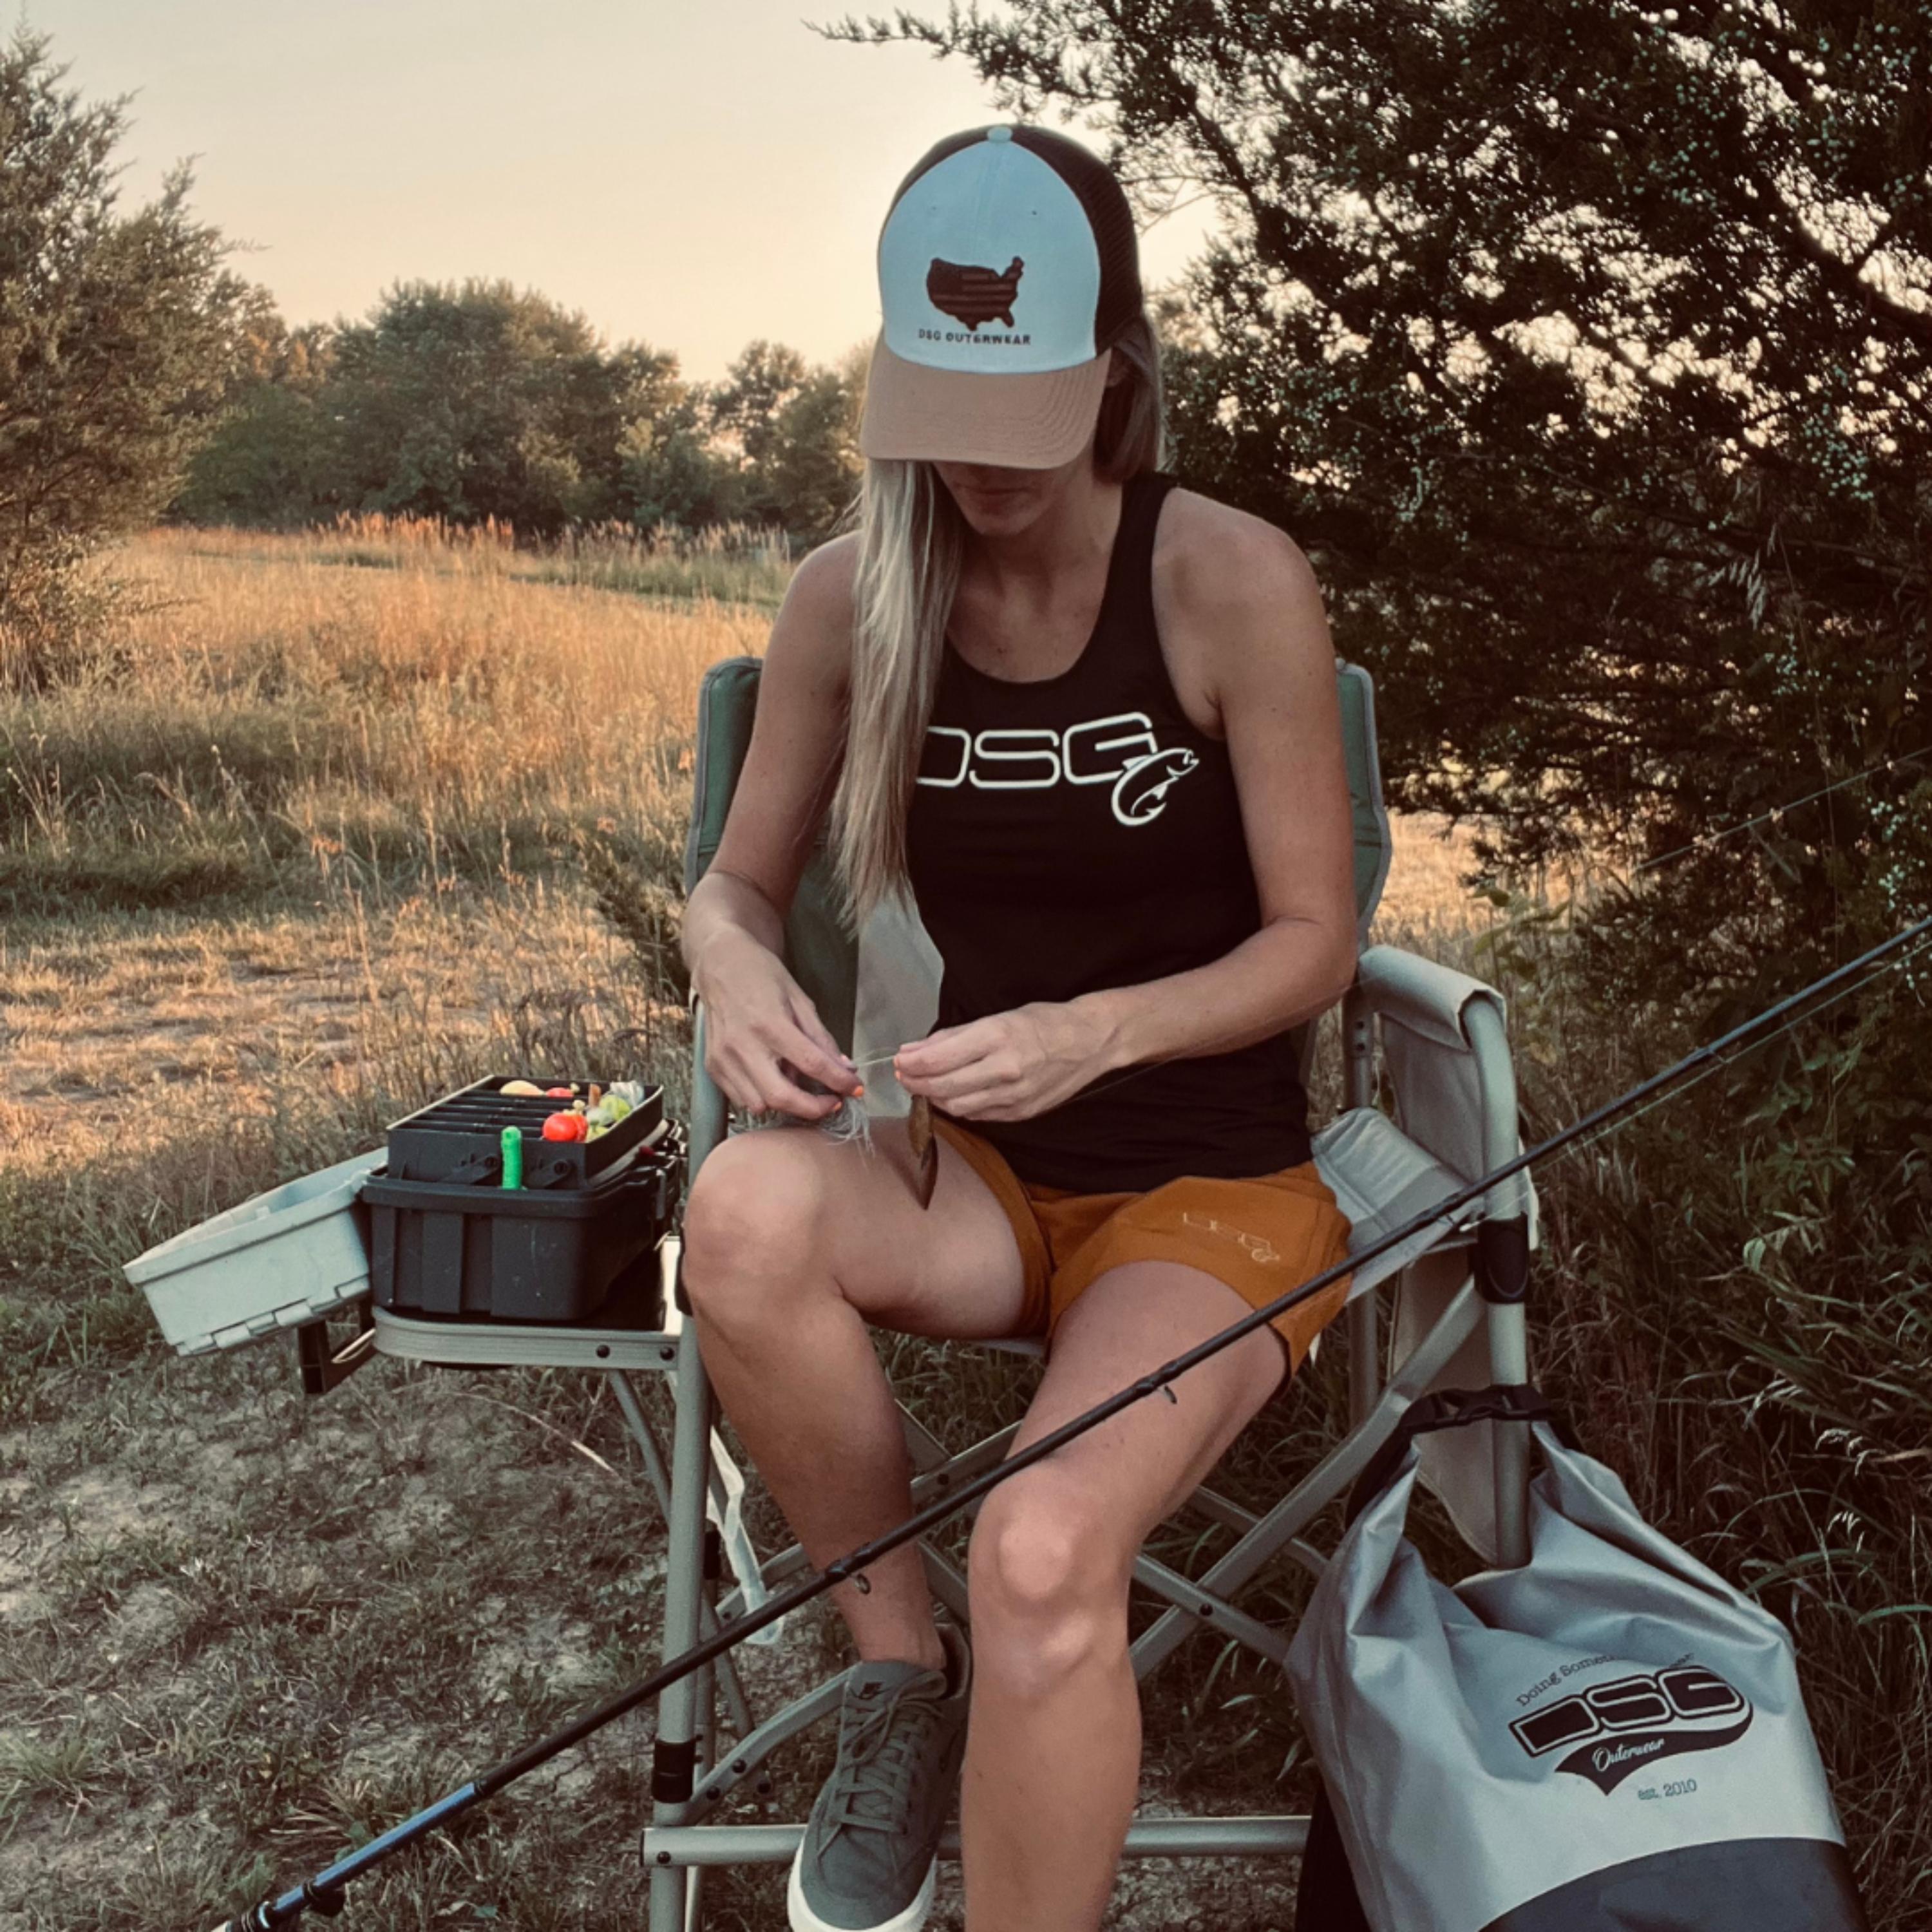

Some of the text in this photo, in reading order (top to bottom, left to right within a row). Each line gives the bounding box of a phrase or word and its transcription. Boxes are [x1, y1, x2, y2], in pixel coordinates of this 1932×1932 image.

[919, 328, 1030, 345] DSG OUTERWEAR
[1516, 1672, 1562, 1707] Doing
[1508, 1665, 1745, 1758] DSG
[1592, 1738, 1665, 1772] Outerwear
[1663, 1779, 1698, 1797] 2010
